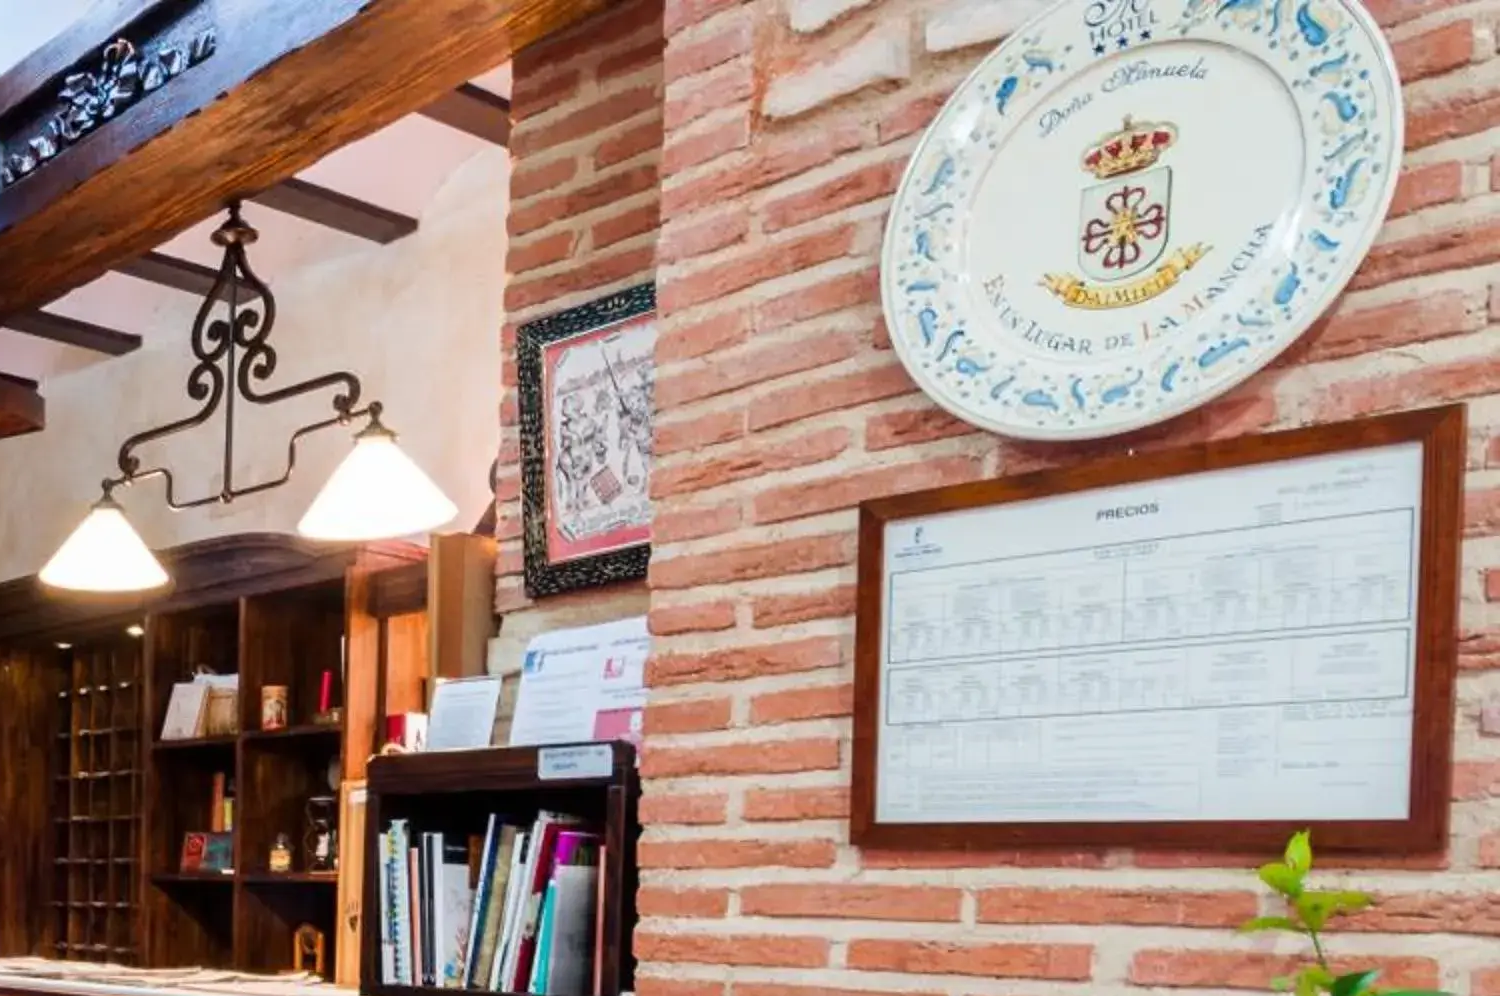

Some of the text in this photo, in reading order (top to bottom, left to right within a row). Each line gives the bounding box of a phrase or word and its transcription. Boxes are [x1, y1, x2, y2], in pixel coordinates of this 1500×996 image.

[1089, 10, 1158, 43] HOTEL
[1038, 56, 1208, 139] Doña Manuela
[1022, 320, 1093, 355] LUGAR
[1104, 333, 1135, 350] DE
[1140, 314, 1180, 342] LA
[1179, 221, 1274, 315] MANCHA
[1095, 502, 1160, 522] PRECIOS
